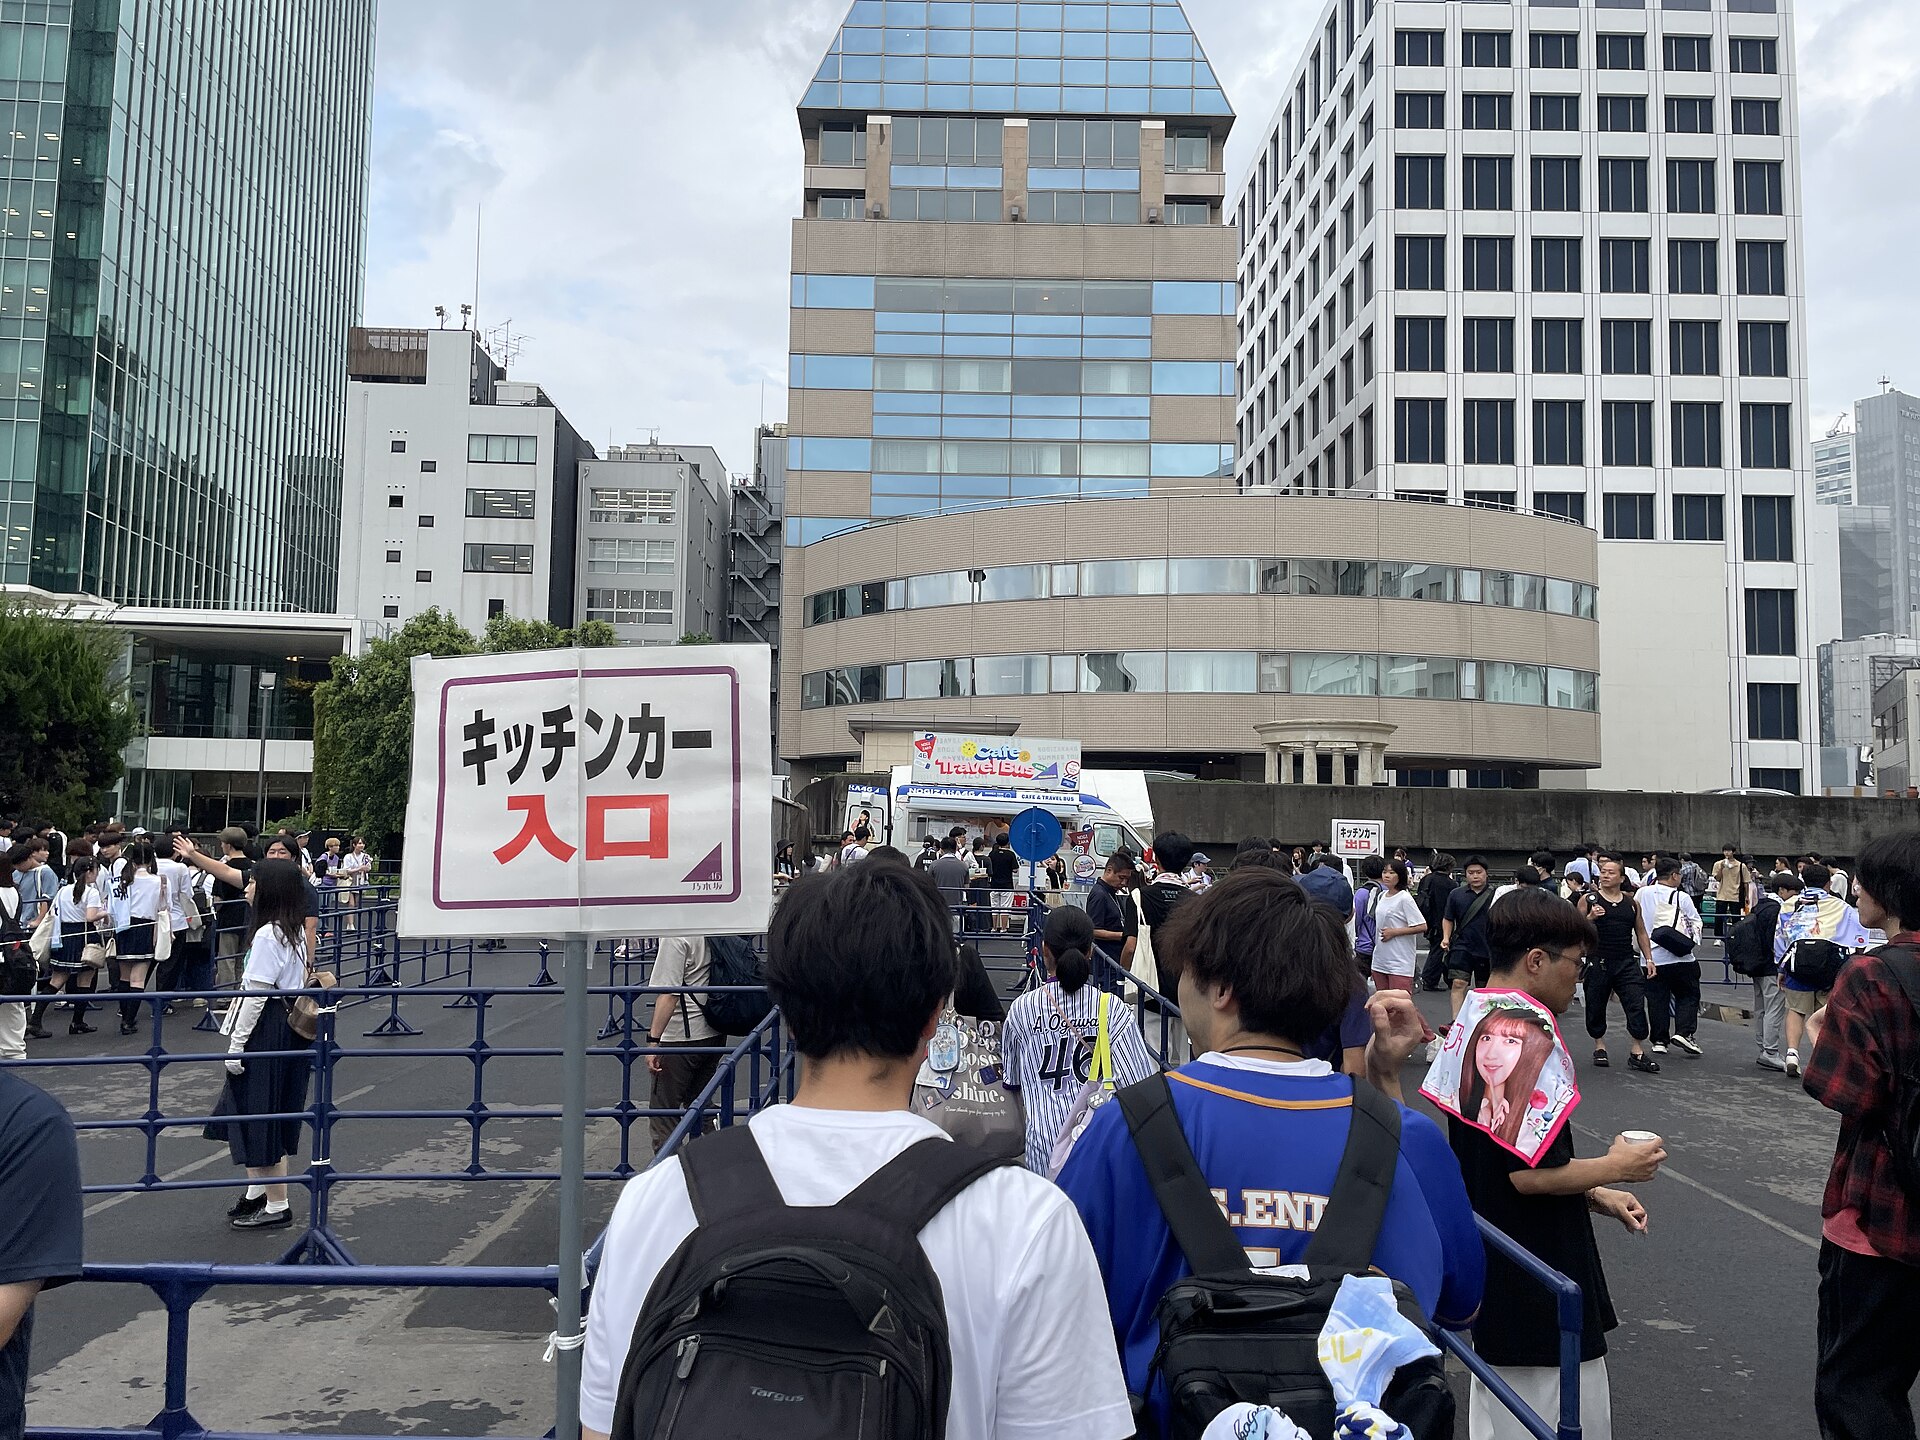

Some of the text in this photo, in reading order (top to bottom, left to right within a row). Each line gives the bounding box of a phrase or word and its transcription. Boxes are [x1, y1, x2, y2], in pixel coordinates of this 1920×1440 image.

[463, 703, 712, 785] キッチンカー
[974, 744, 1020, 760] Cafe
[935, 757, 1034, 779] Travel Bus
[493, 794, 669, 865] 入口
[1340, 827, 1377, 838] キッチンカー
[1345, 839, 1371, 850] 出口
[708, 872, 722, 881] 46
[1038, 1035, 1103, 1090] 46
[951, 1081, 1005, 1103] shine.
[750, 1386, 804, 1402] Targus
